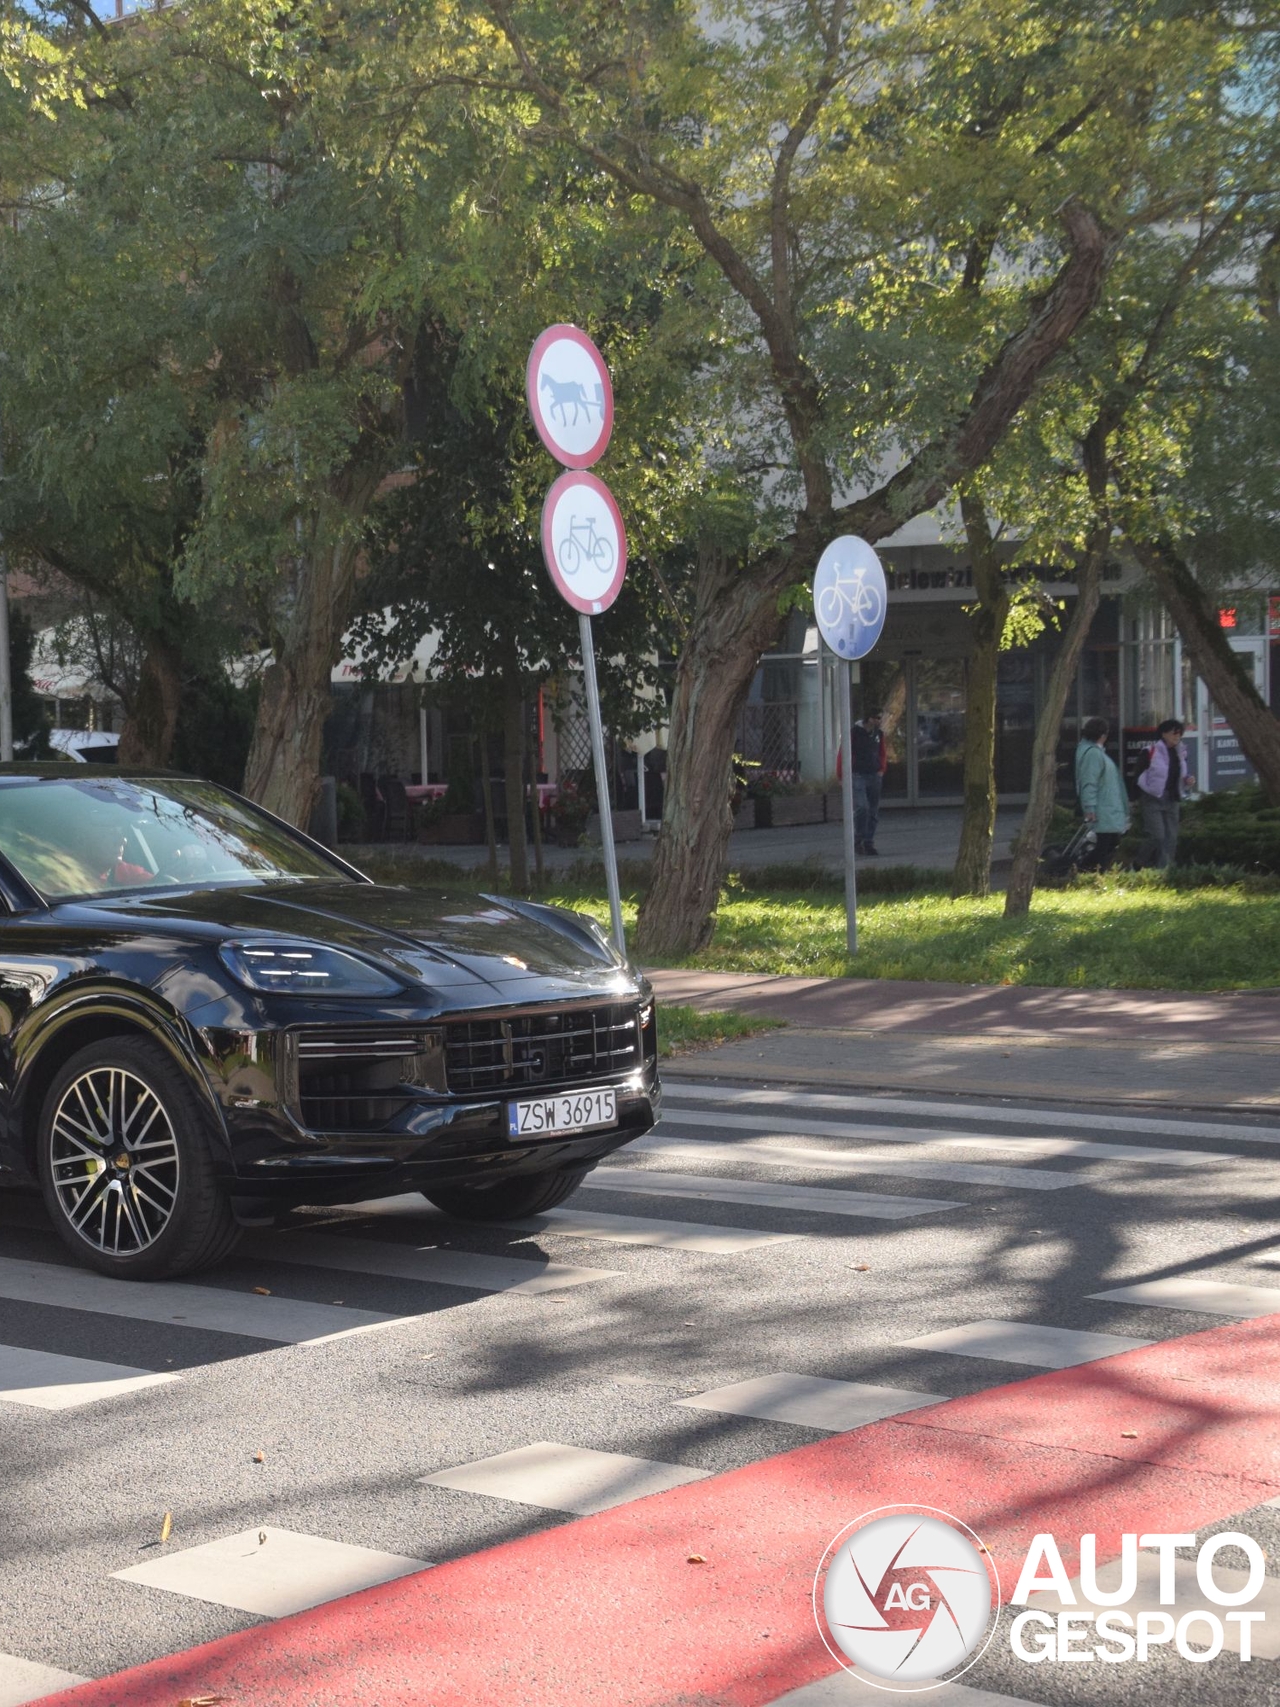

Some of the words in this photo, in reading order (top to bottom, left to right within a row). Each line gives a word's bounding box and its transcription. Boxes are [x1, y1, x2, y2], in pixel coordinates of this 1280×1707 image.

[519, 1101, 556, 1132] ZSW
[562, 1092, 614, 1126] 36915
[510, 1122, 518, 1132] PL
